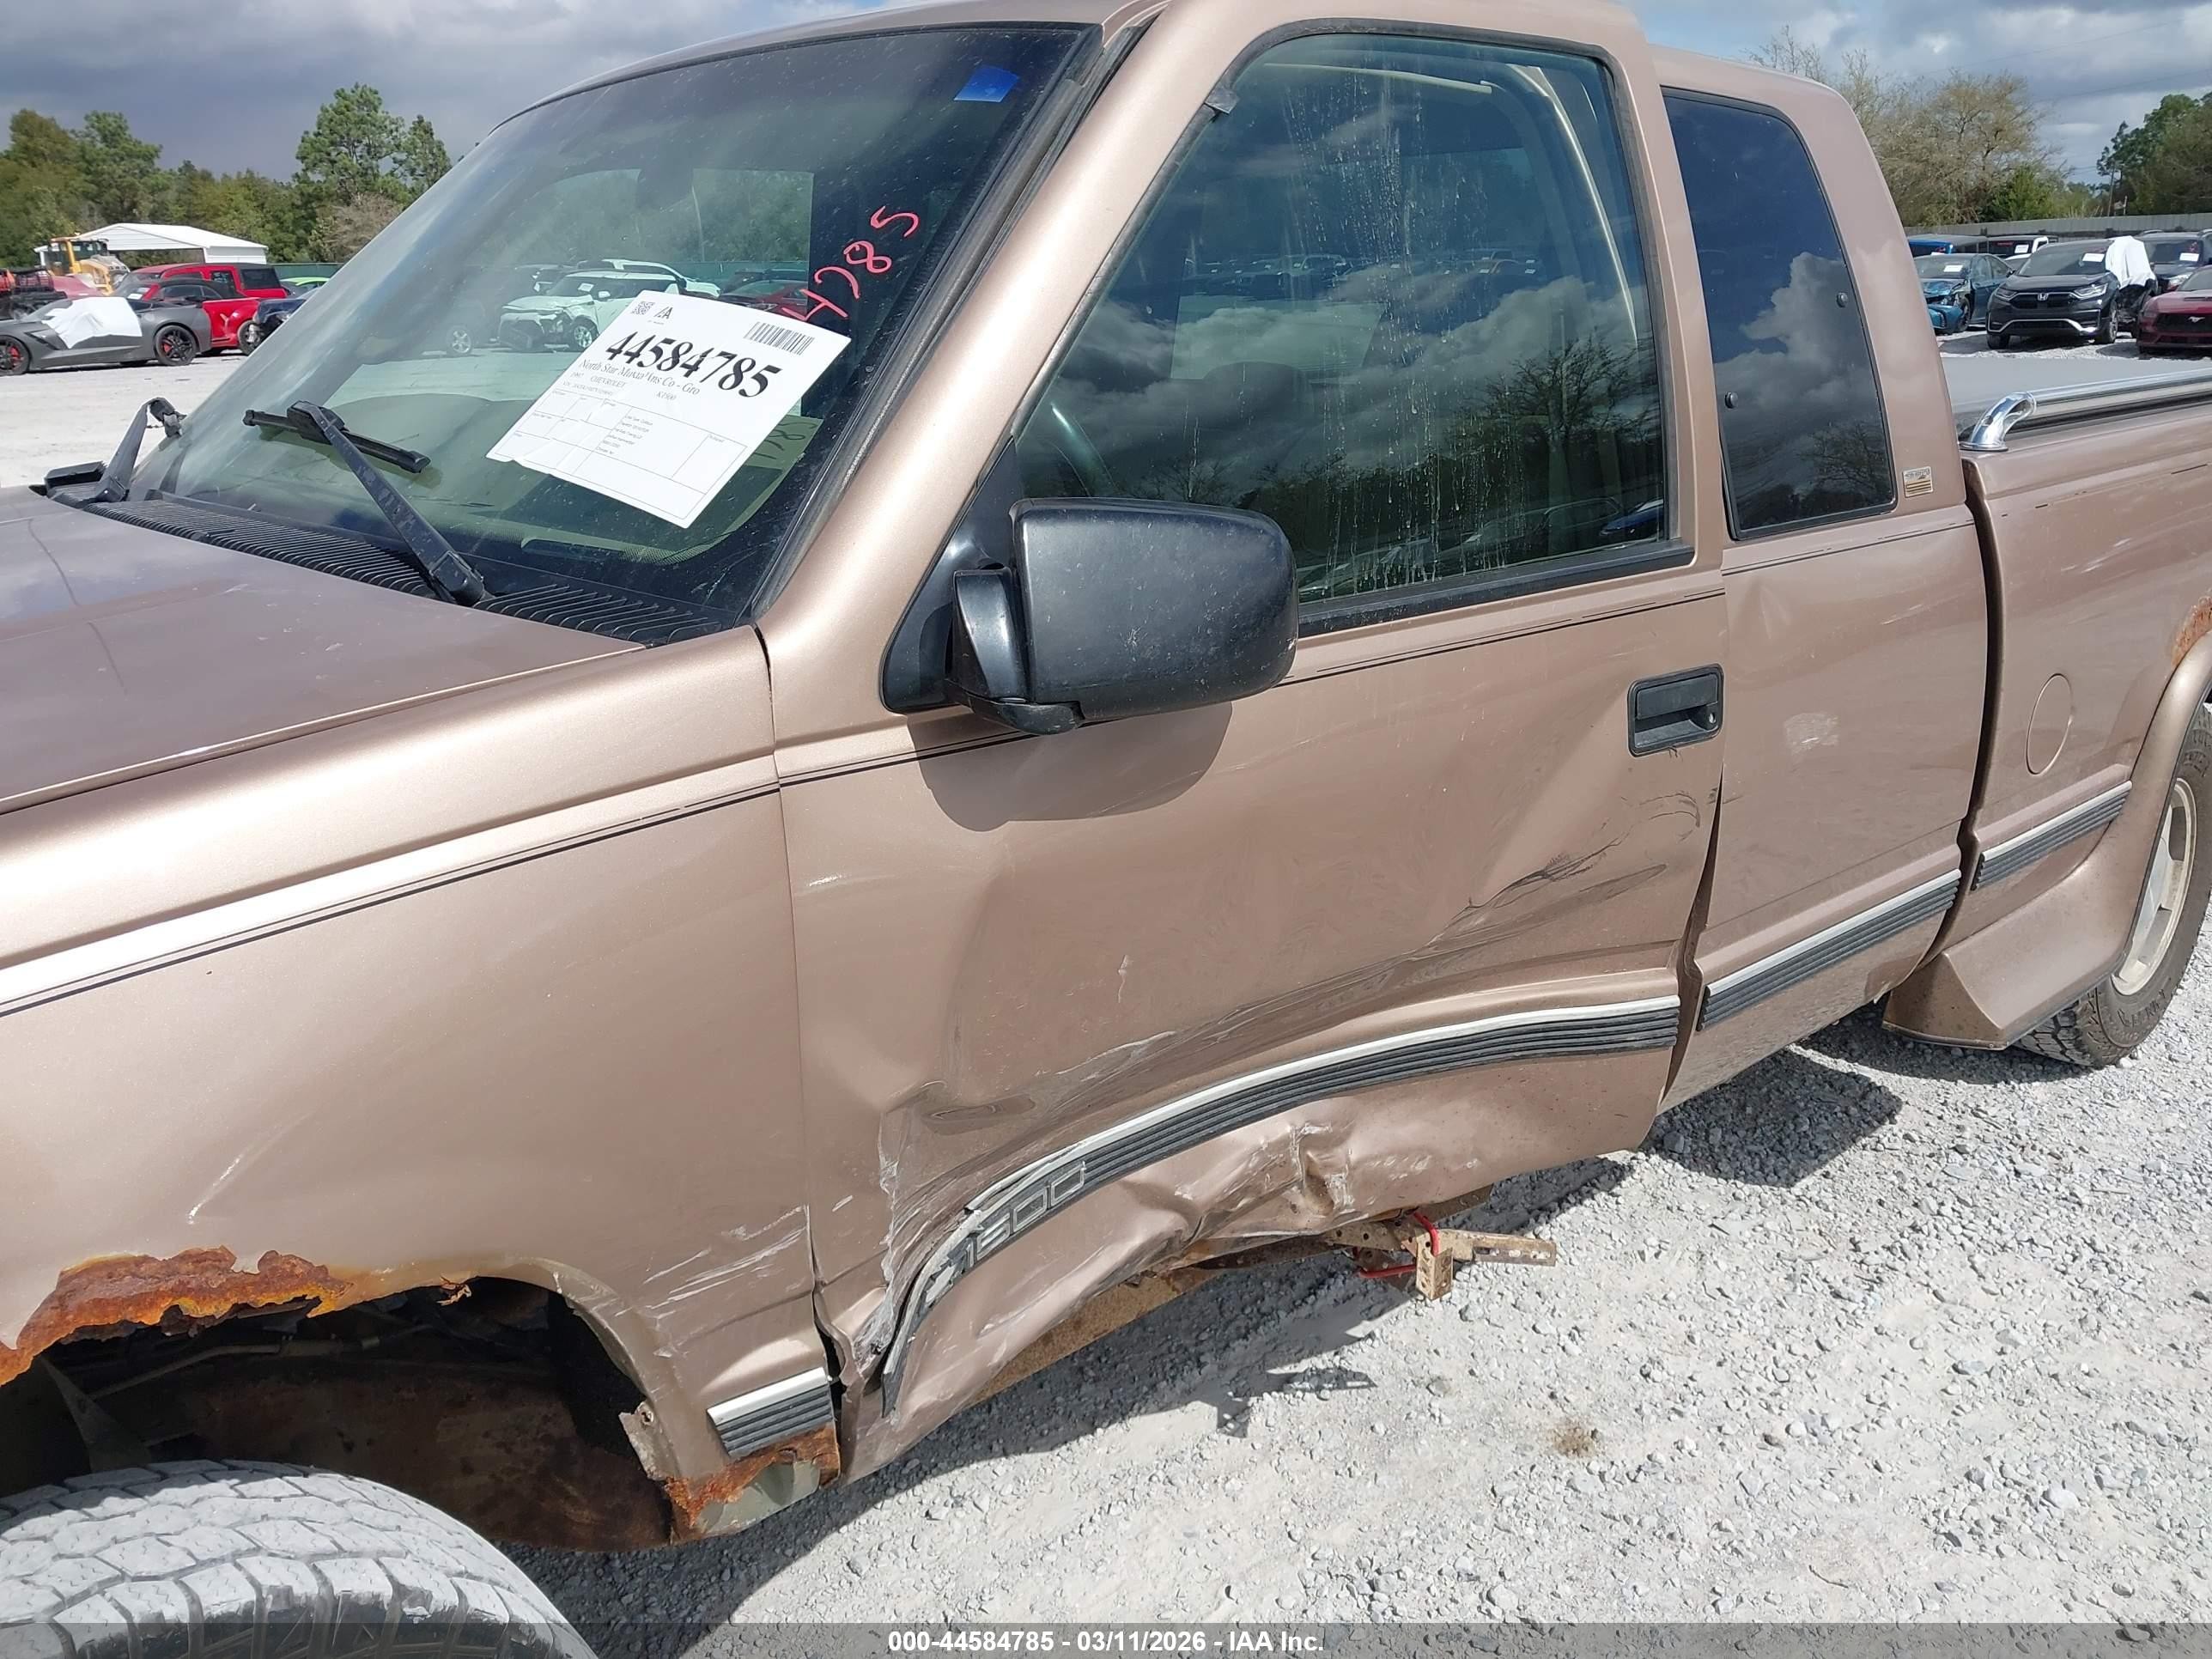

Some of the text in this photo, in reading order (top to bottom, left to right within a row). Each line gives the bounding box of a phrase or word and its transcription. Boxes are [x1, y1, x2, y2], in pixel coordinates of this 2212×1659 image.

[781, 205, 920, 319] 4785
[578, 359, 602, 373] North
[600, 363, 619, 375] Star
[662, 376, 676, 387] Co
[682, 382, 701, 395] Gro
[605, 331, 782, 398] 44584785
